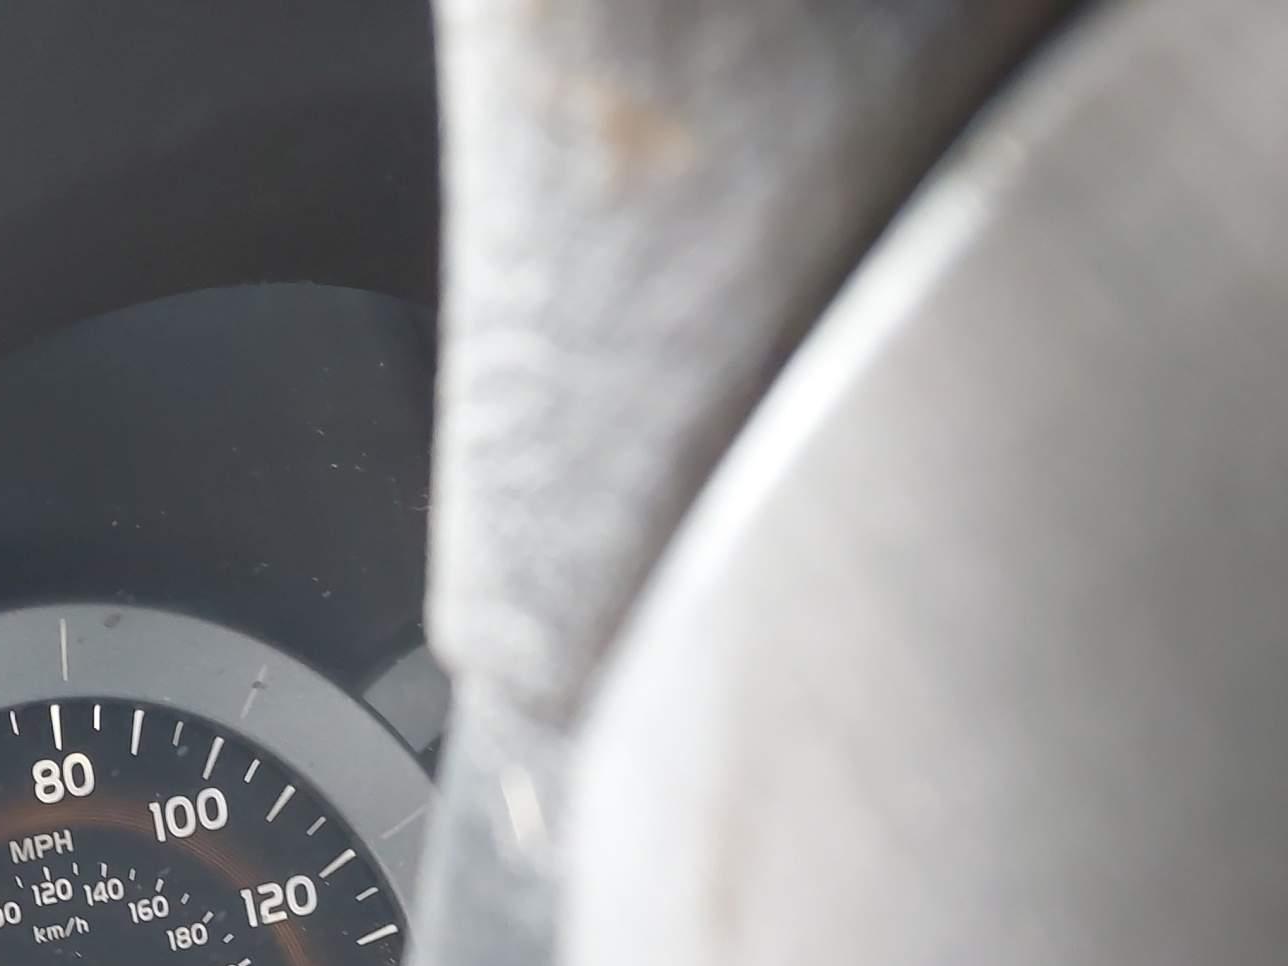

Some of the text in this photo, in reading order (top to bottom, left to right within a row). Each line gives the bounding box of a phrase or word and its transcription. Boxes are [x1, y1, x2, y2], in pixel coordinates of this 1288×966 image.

[31, 752, 95, 804] 80
[149, 788, 228, 842] 100
[9, 829, 74, 864] MPH
[31, 878, 73, 906] 120
[83, 877, 124, 906] 140
[240, 875, 318, 928] 120
[128, 896, 169, 923] 160
[32, 916, 90, 943] km/h
[166, 923, 208, 951] 180
